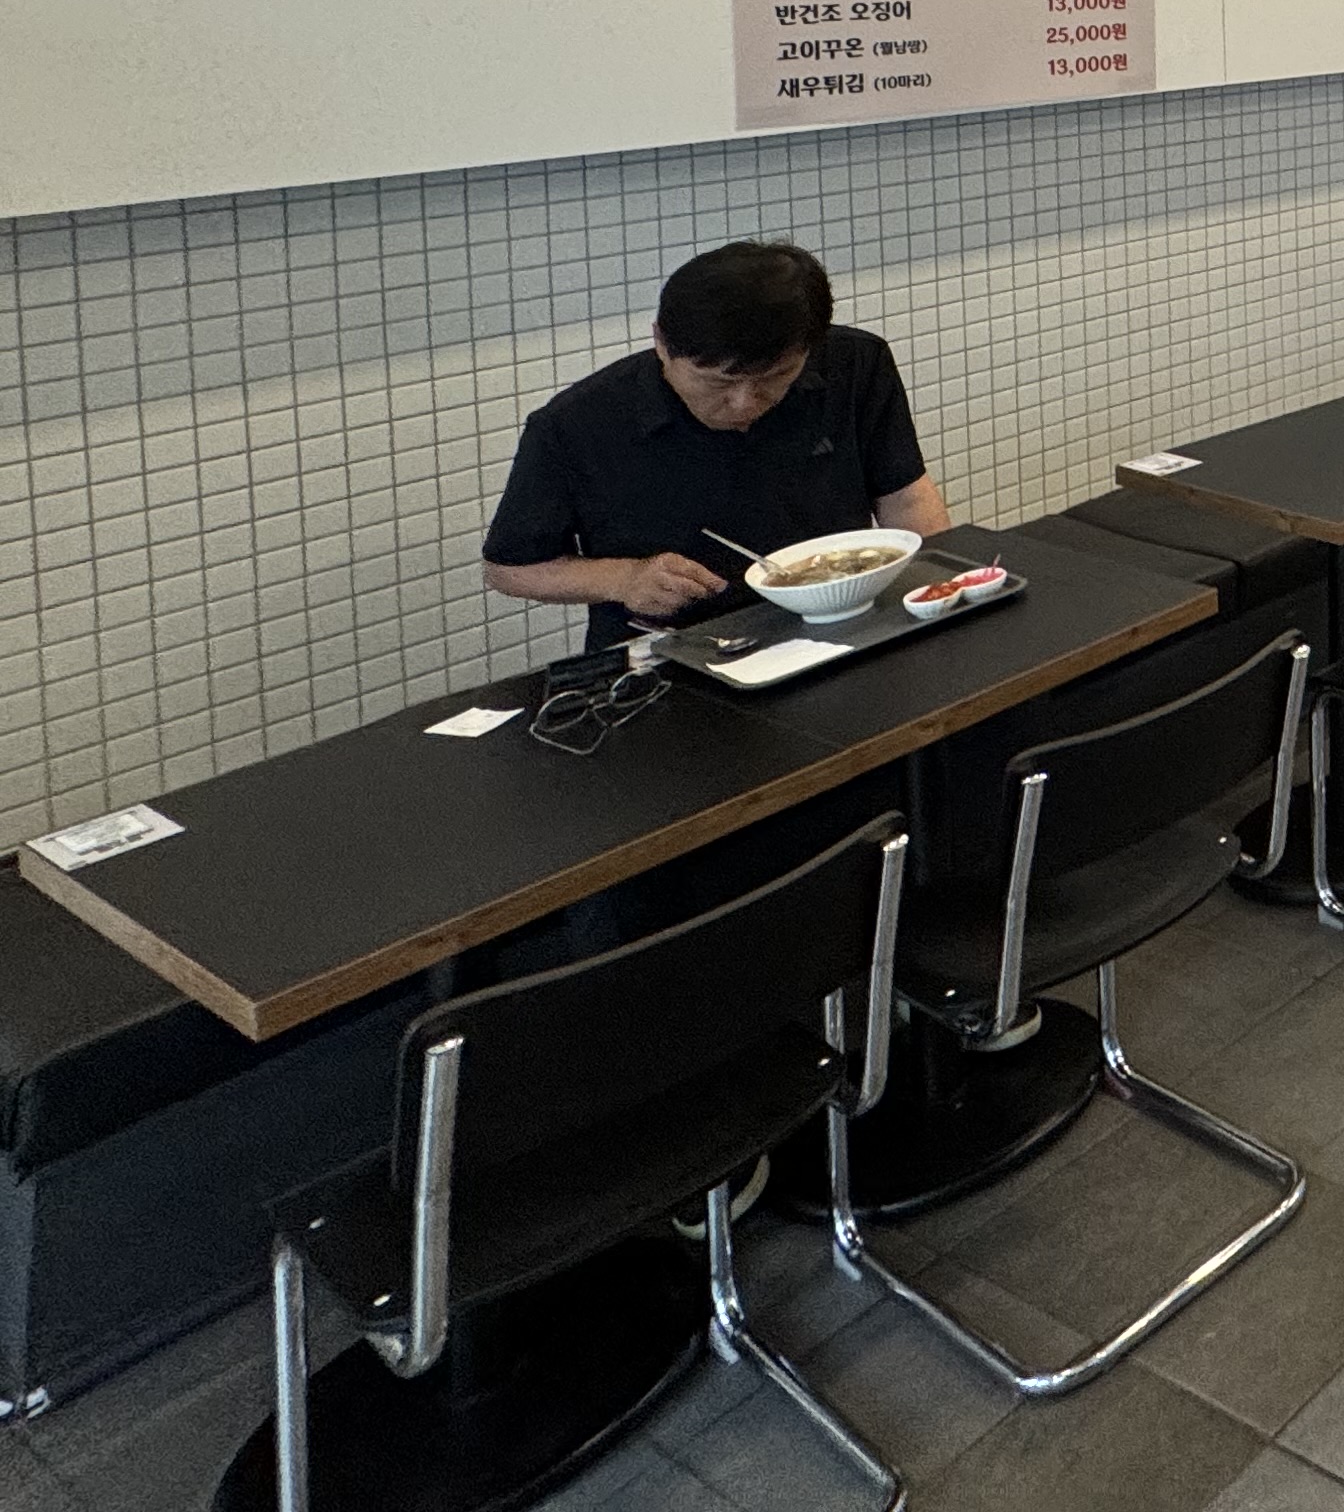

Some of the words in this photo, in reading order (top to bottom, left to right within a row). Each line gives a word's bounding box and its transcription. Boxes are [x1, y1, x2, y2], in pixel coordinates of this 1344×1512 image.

[775, 3, 843, 25] 반건조
[849, 0, 912, 21] 오징어
[1046, 22, 1127, 45] 25,000원
[777, 38, 865, 62] 고이꾸온
[872, 38, 928, 57] (월남쌈)
[1048, 53, 1128, 77] 13,000원
[777, 75, 865, 99] 새우튀김
[873, 73, 932, 92] (10마리)
